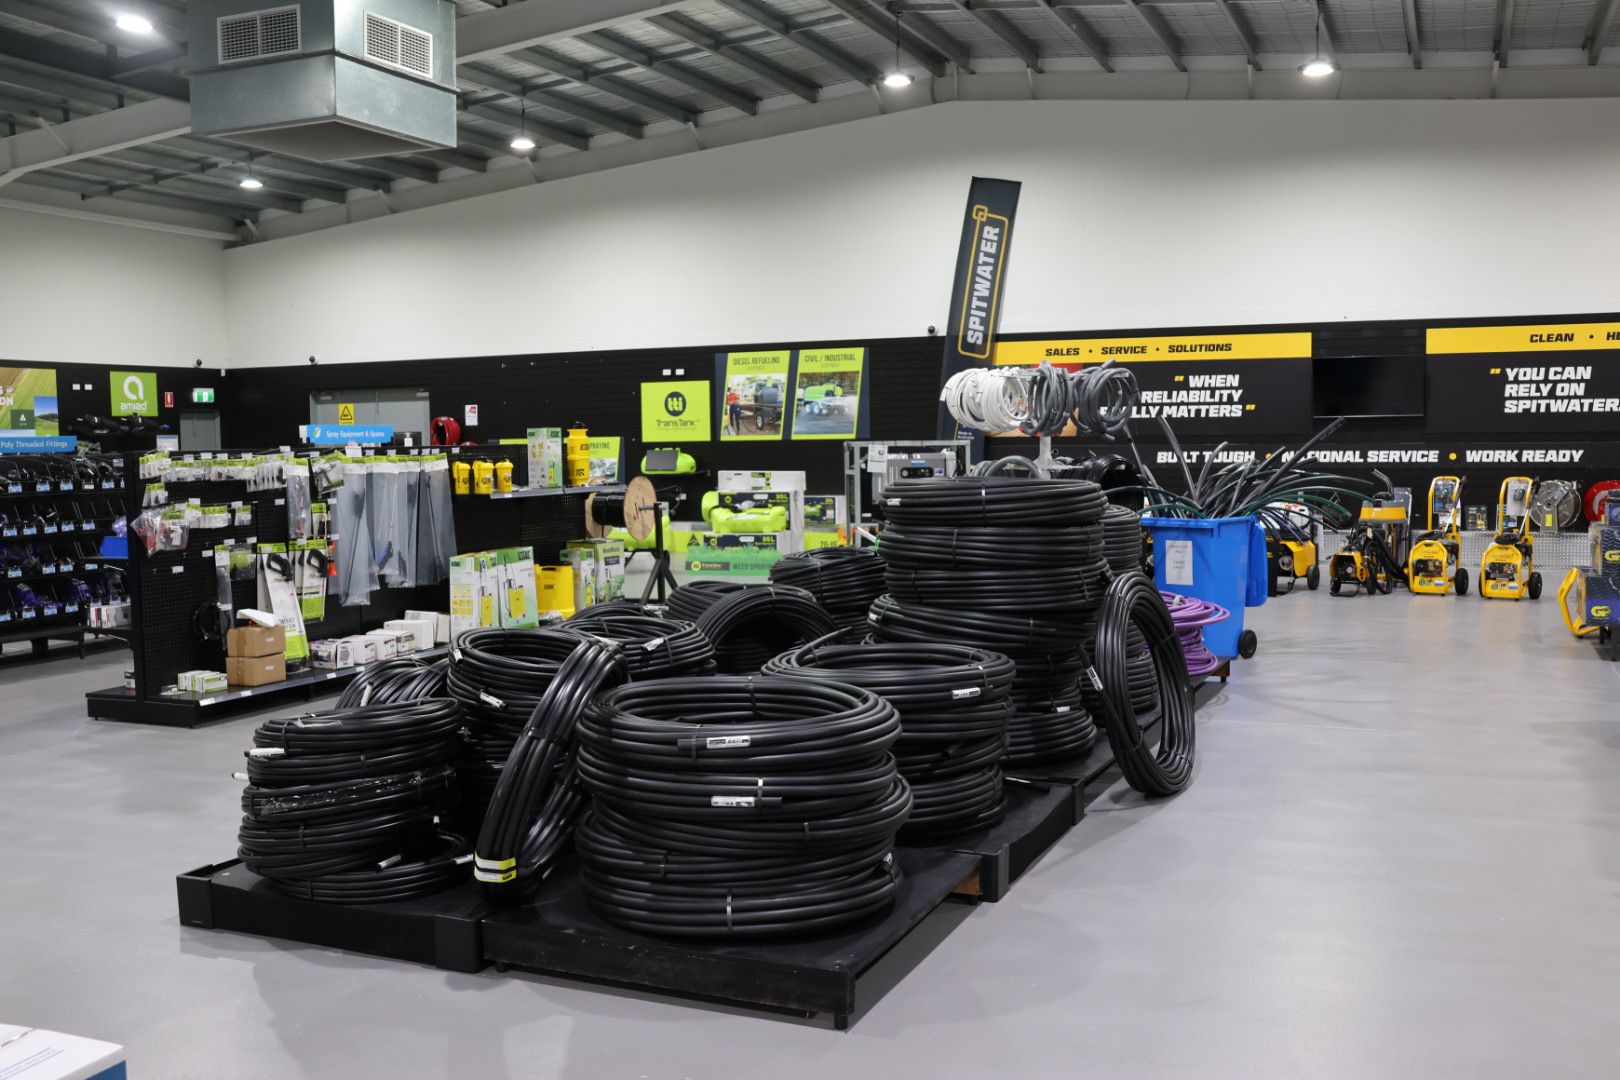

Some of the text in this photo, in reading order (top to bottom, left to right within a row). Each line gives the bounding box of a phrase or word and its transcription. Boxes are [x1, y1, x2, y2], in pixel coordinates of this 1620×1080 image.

[967, 225, 1000, 345] SPITWATER
[1529, 333, 1574, 343] CLEAN
[1045, 343, 1232, 357] SALES SERVICE SOLUTIONS
[1548, 366, 1592, 380] CAN
[1141, 389, 1243, 404] RELIABILITY
[1504, 382, 1586, 397] RELY ON
[120, 401, 147, 410] amiad
[326, 430, 339, 438] Spray
[1, 441, 14, 449] Poly
[1156, 450, 1200, 464] BULT
[1366, 450, 1440, 463] SERVICE
[1465, 450, 1519, 463] WORK
[1521, 450, 1585, 463] READY
